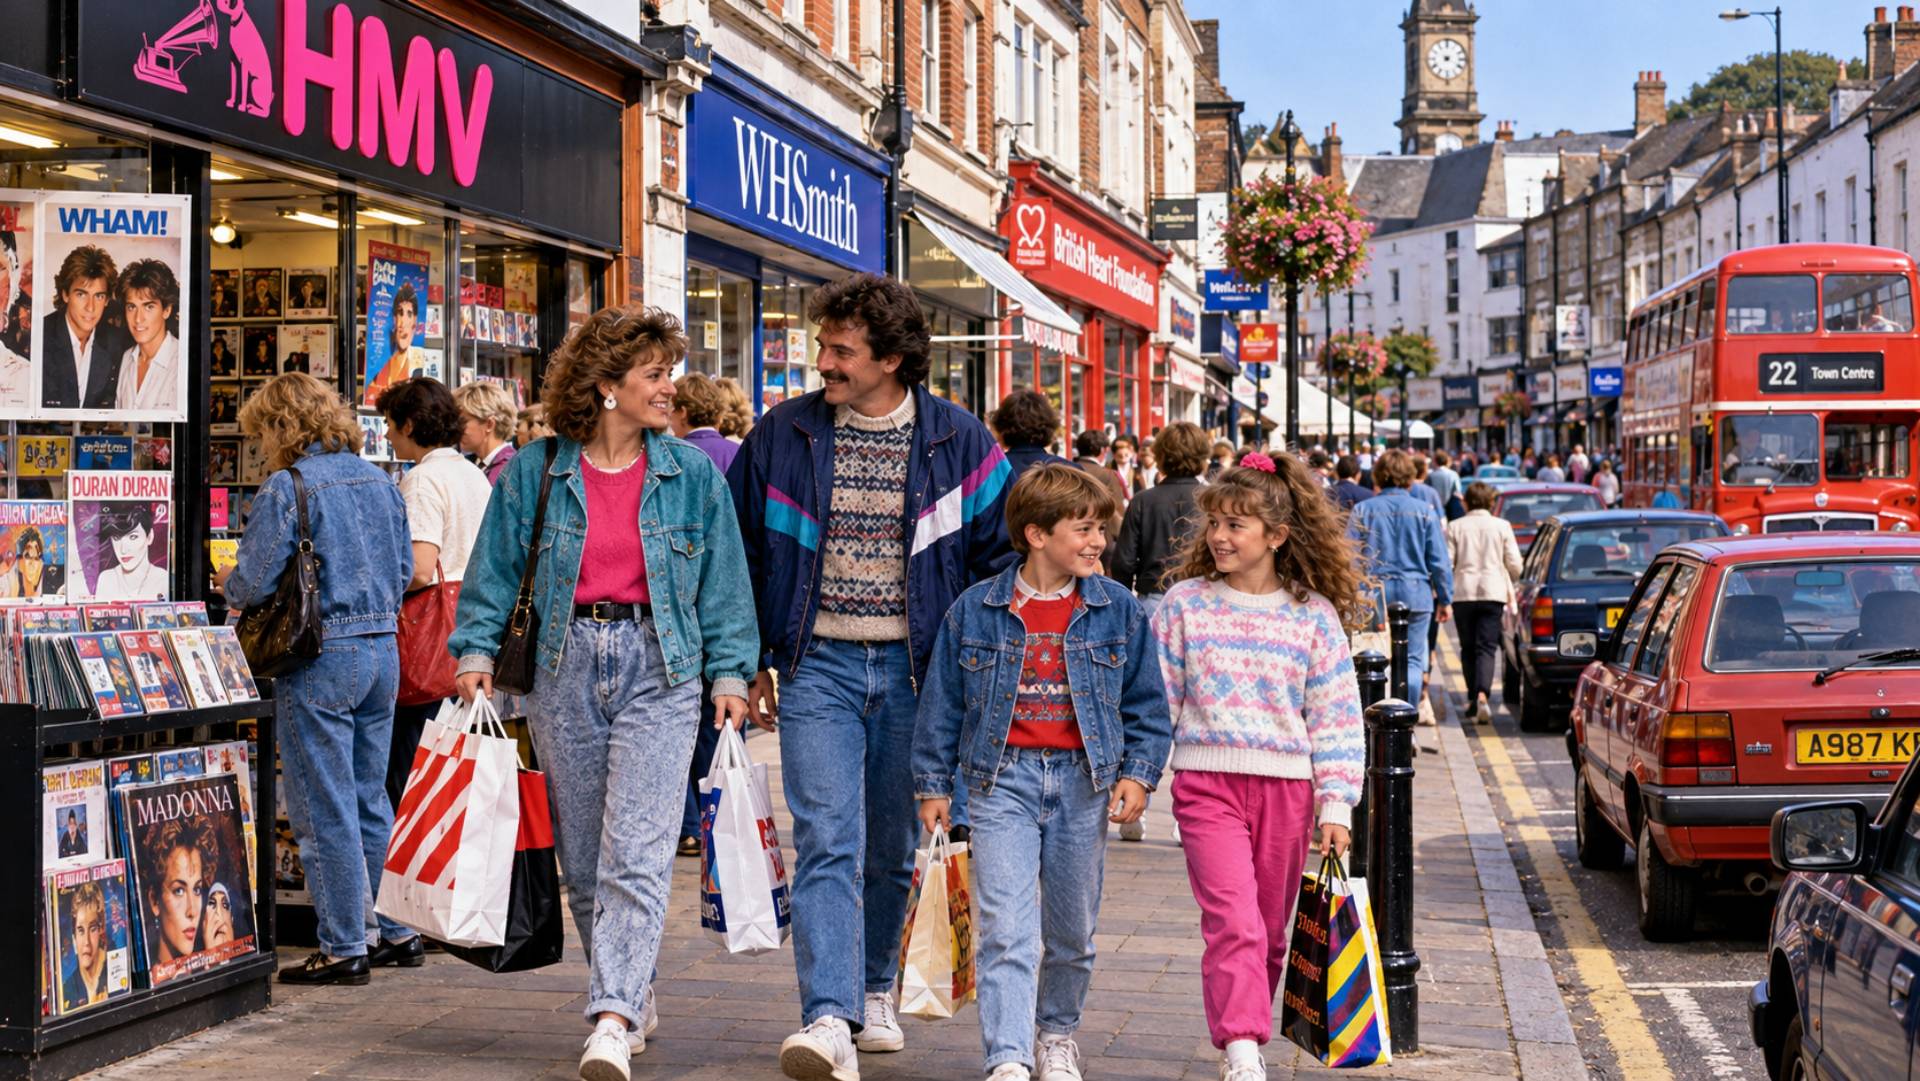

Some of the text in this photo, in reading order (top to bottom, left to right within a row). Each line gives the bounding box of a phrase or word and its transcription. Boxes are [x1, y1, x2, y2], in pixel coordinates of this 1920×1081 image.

[283, 0, 493, 187] HMV
[733, 117, 860, 255] WHSmith
[58, 207, 168, 236] WHAM!
[1054, 223, 1155, 307] British Heart Foundation
[1768, 361, 1876, 386] 22 Town Centre
[72, 476, 169, 497] DURAN DURAN
[1808, 732, 1883, 758] A987
[137, 784, 235, 827] MADONNA
